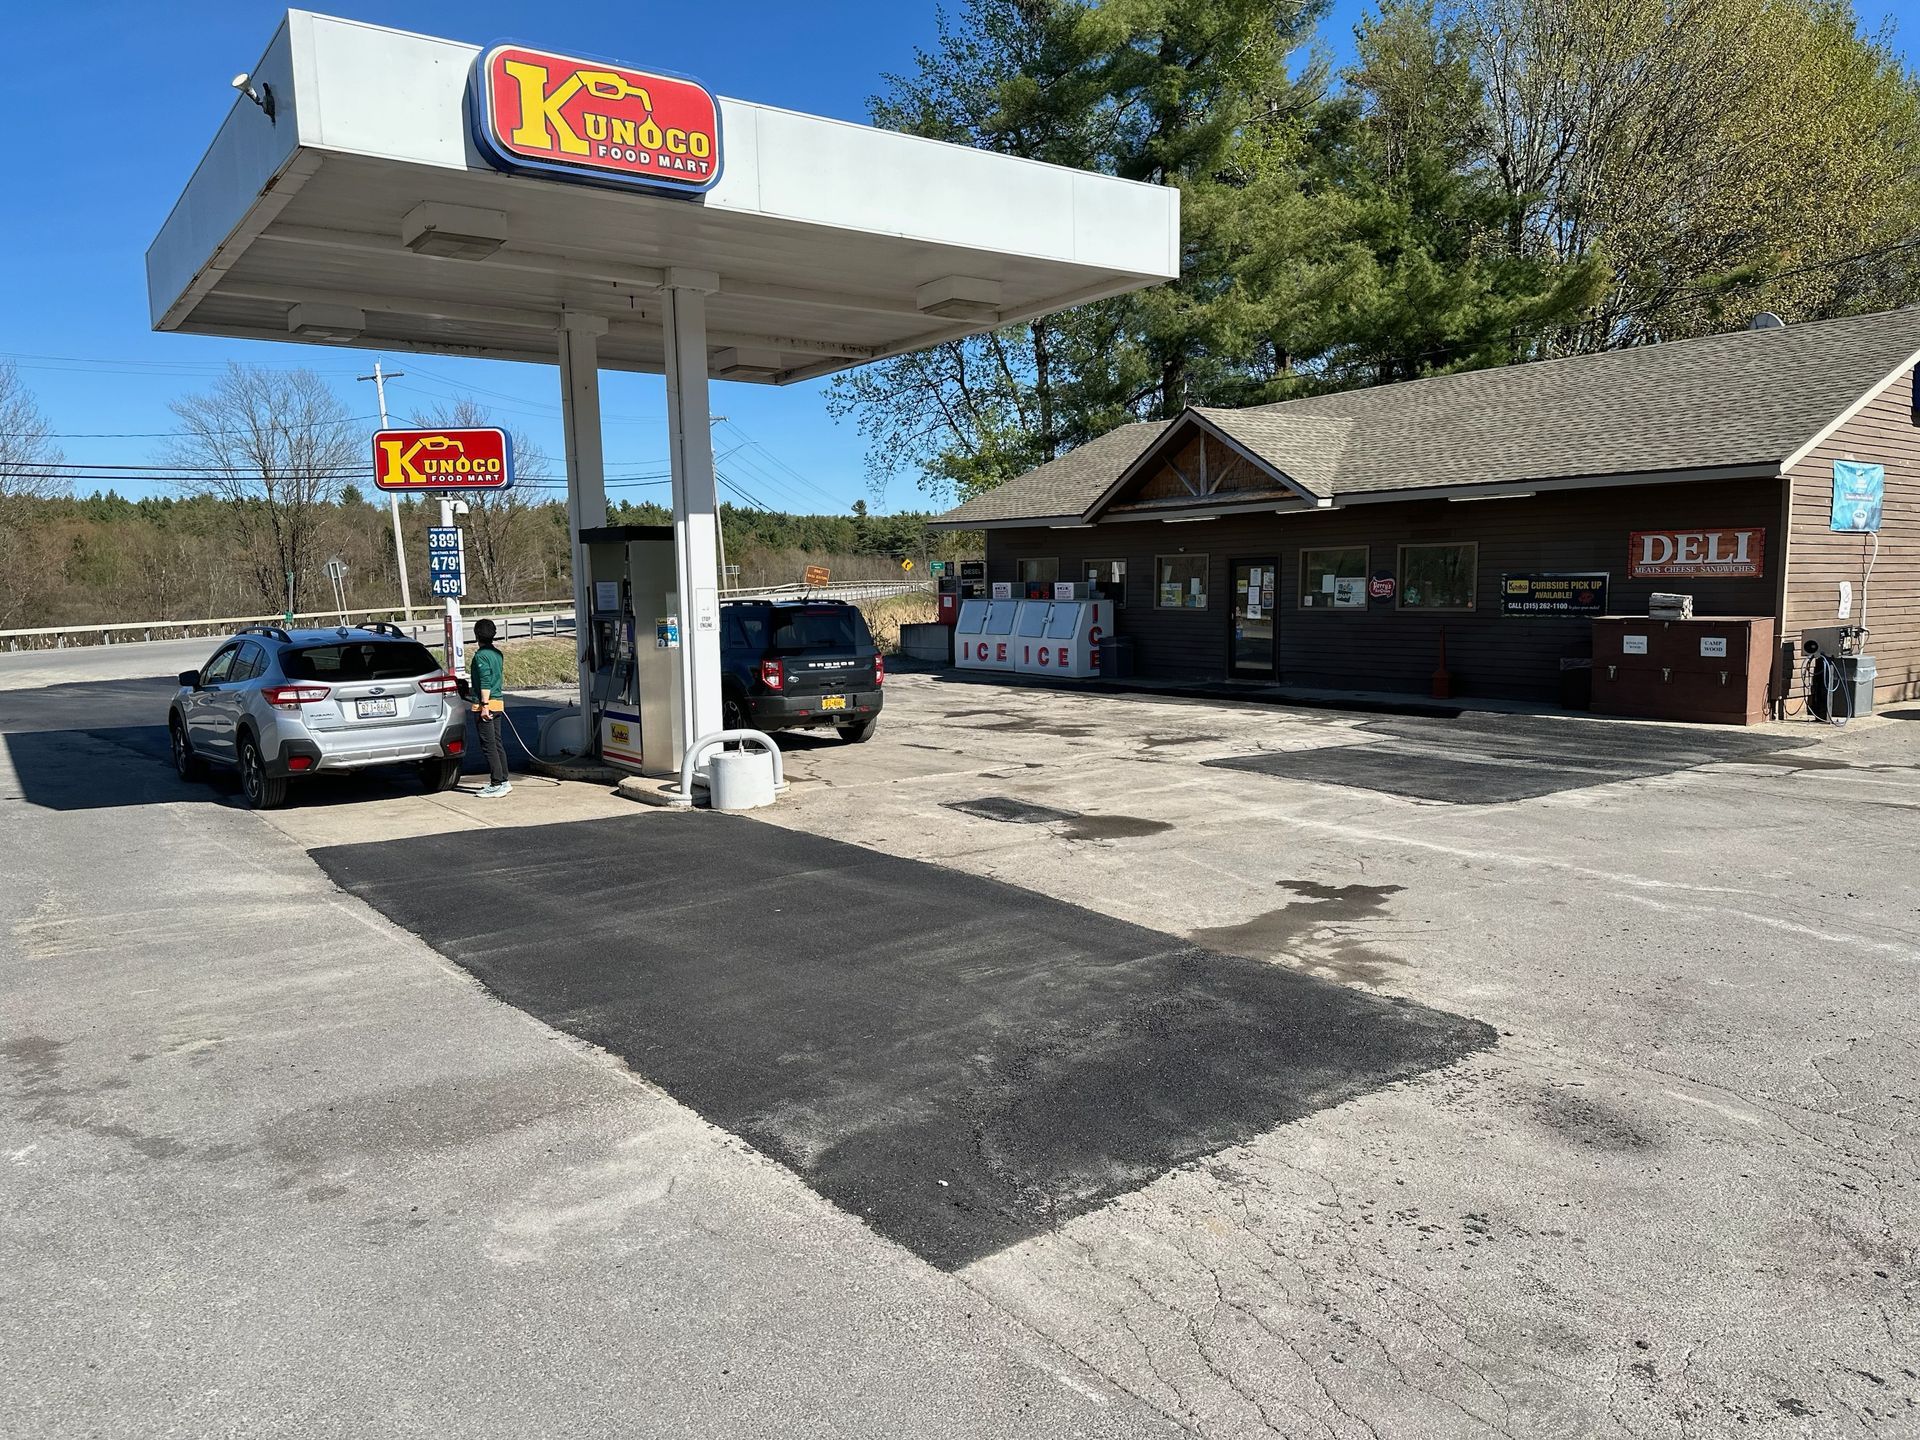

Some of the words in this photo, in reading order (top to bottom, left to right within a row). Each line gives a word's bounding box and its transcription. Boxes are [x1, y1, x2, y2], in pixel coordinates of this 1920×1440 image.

[504, 59, 711, 158] KUNOCO
[598, 145, 651, 165] FOOD
[657, 156, 710, 174] MART
[379, 440, 500, 483] KUNOCO
[1639, 532, 1753, 565] DELI
[1634, 566, 1661, 574] MEATS
[1700, 565, 1756, 573] SANDWICHES
[1531, 581, 1569, 590] CURBSIDE
[1570, 581, 1589, 590] PICK
[1591, 580, 1603, 589] UP
[1535, 591, 1573, 599] AVAILABLE!
[1523, 602, 1538, 610] (315)
[1539, 602, 1568, 610] 262-1100
[1088, 604, 1102, 669] ICE
[964, 642, 1007, 661] ICE
[1025, 646, 1068, 667] ICE
